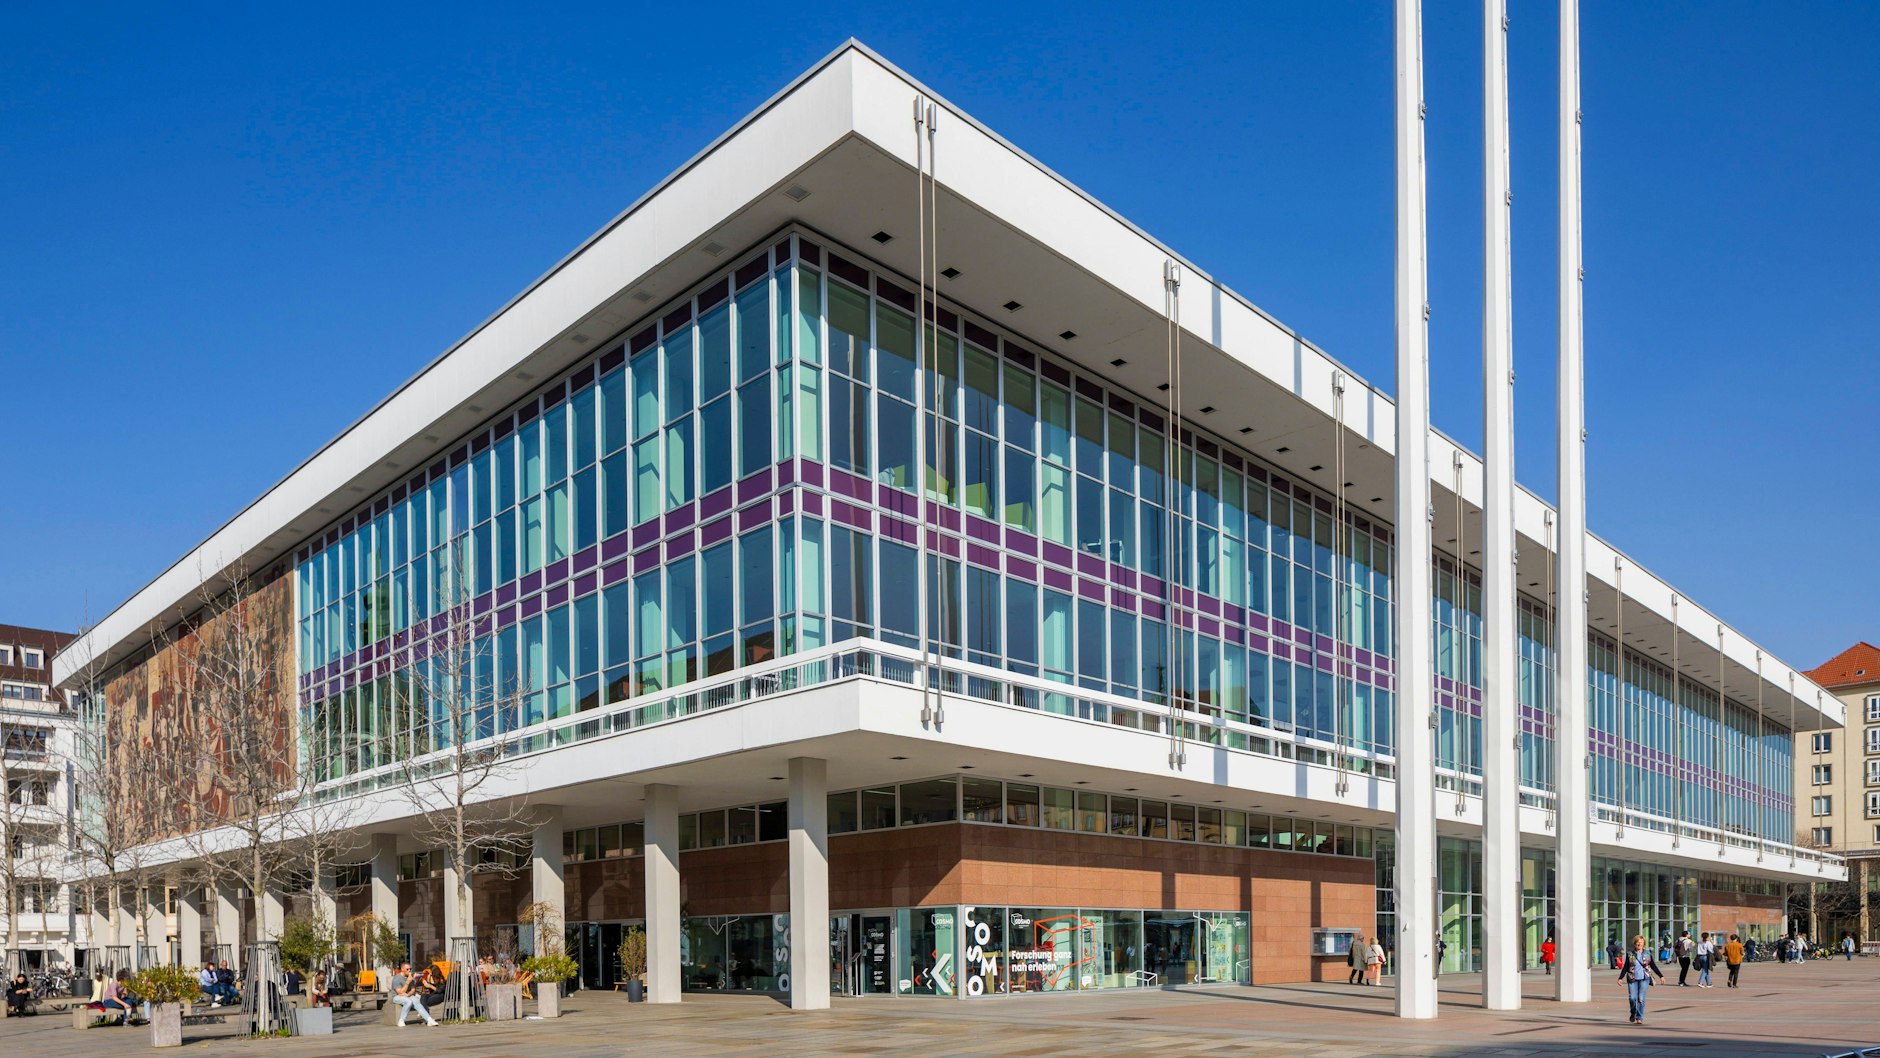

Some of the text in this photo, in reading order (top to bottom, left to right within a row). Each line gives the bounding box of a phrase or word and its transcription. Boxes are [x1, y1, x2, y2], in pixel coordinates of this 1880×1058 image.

[965, 907, 998, 996] COSMO
[1011, 950, 1072, 961] Forschung ganz
[1011, 962, 1057, 972] nah erleben
